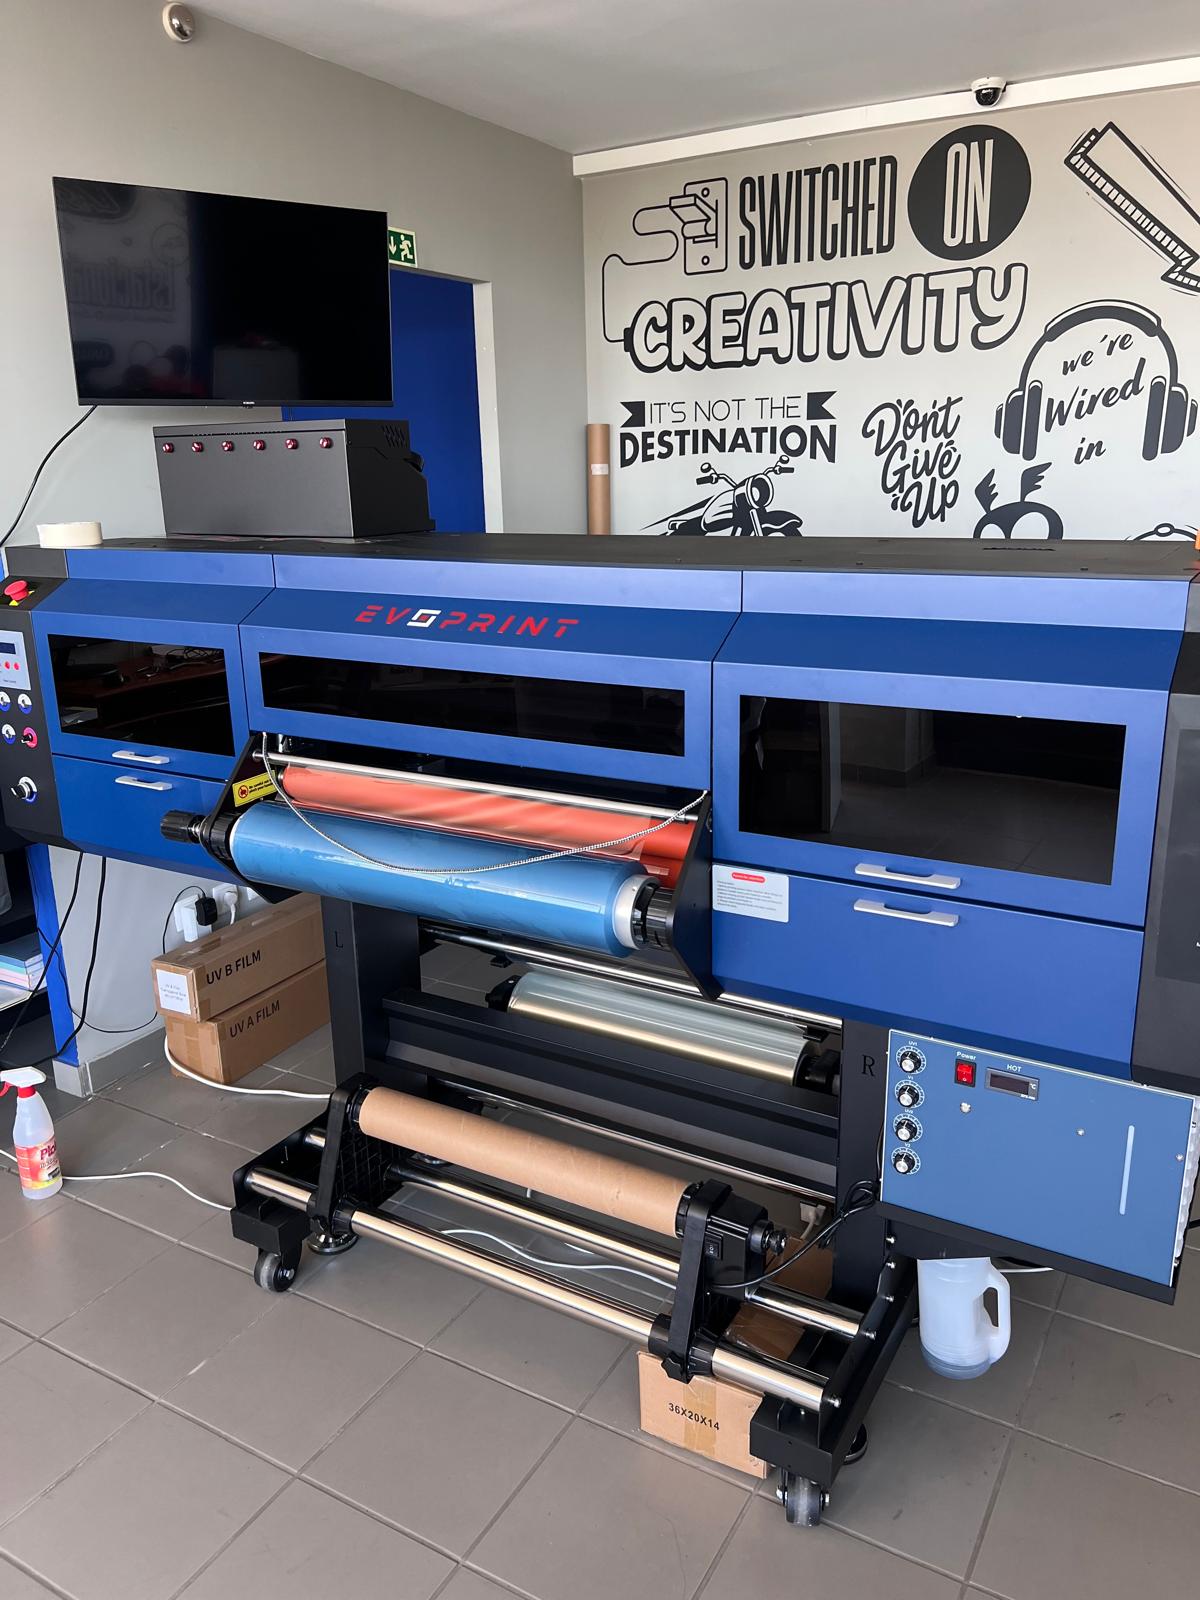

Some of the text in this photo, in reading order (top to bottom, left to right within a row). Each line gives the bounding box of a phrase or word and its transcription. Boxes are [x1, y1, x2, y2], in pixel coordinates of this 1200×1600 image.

[739, 138, 994, 270] SWITCHED ON
[627, 262, 1029, 374] CREATIVITY
[649, 395, 802, 424] IT'S NOT THE
[1044, 357, 1147, 433] Wired
[619, 424, 838, 469] DESTINATION
[1074, 437, 1107, 465] in
[881, 439, 962, 494] Give
[899, 476, 960, 529] Up
[354, 604, 580, 639] EVOPRINT
[206, 949, 261, 985] UV B FILM
[229, 1000, 280, 1038] UV A FILM
[861, 1054, 876, 1077] R
[956, 1051, 977, 1061] Power
[1006, 1064, 1022, 1073] HOT
[668, 1402, 721, 1431] 36X20X14
